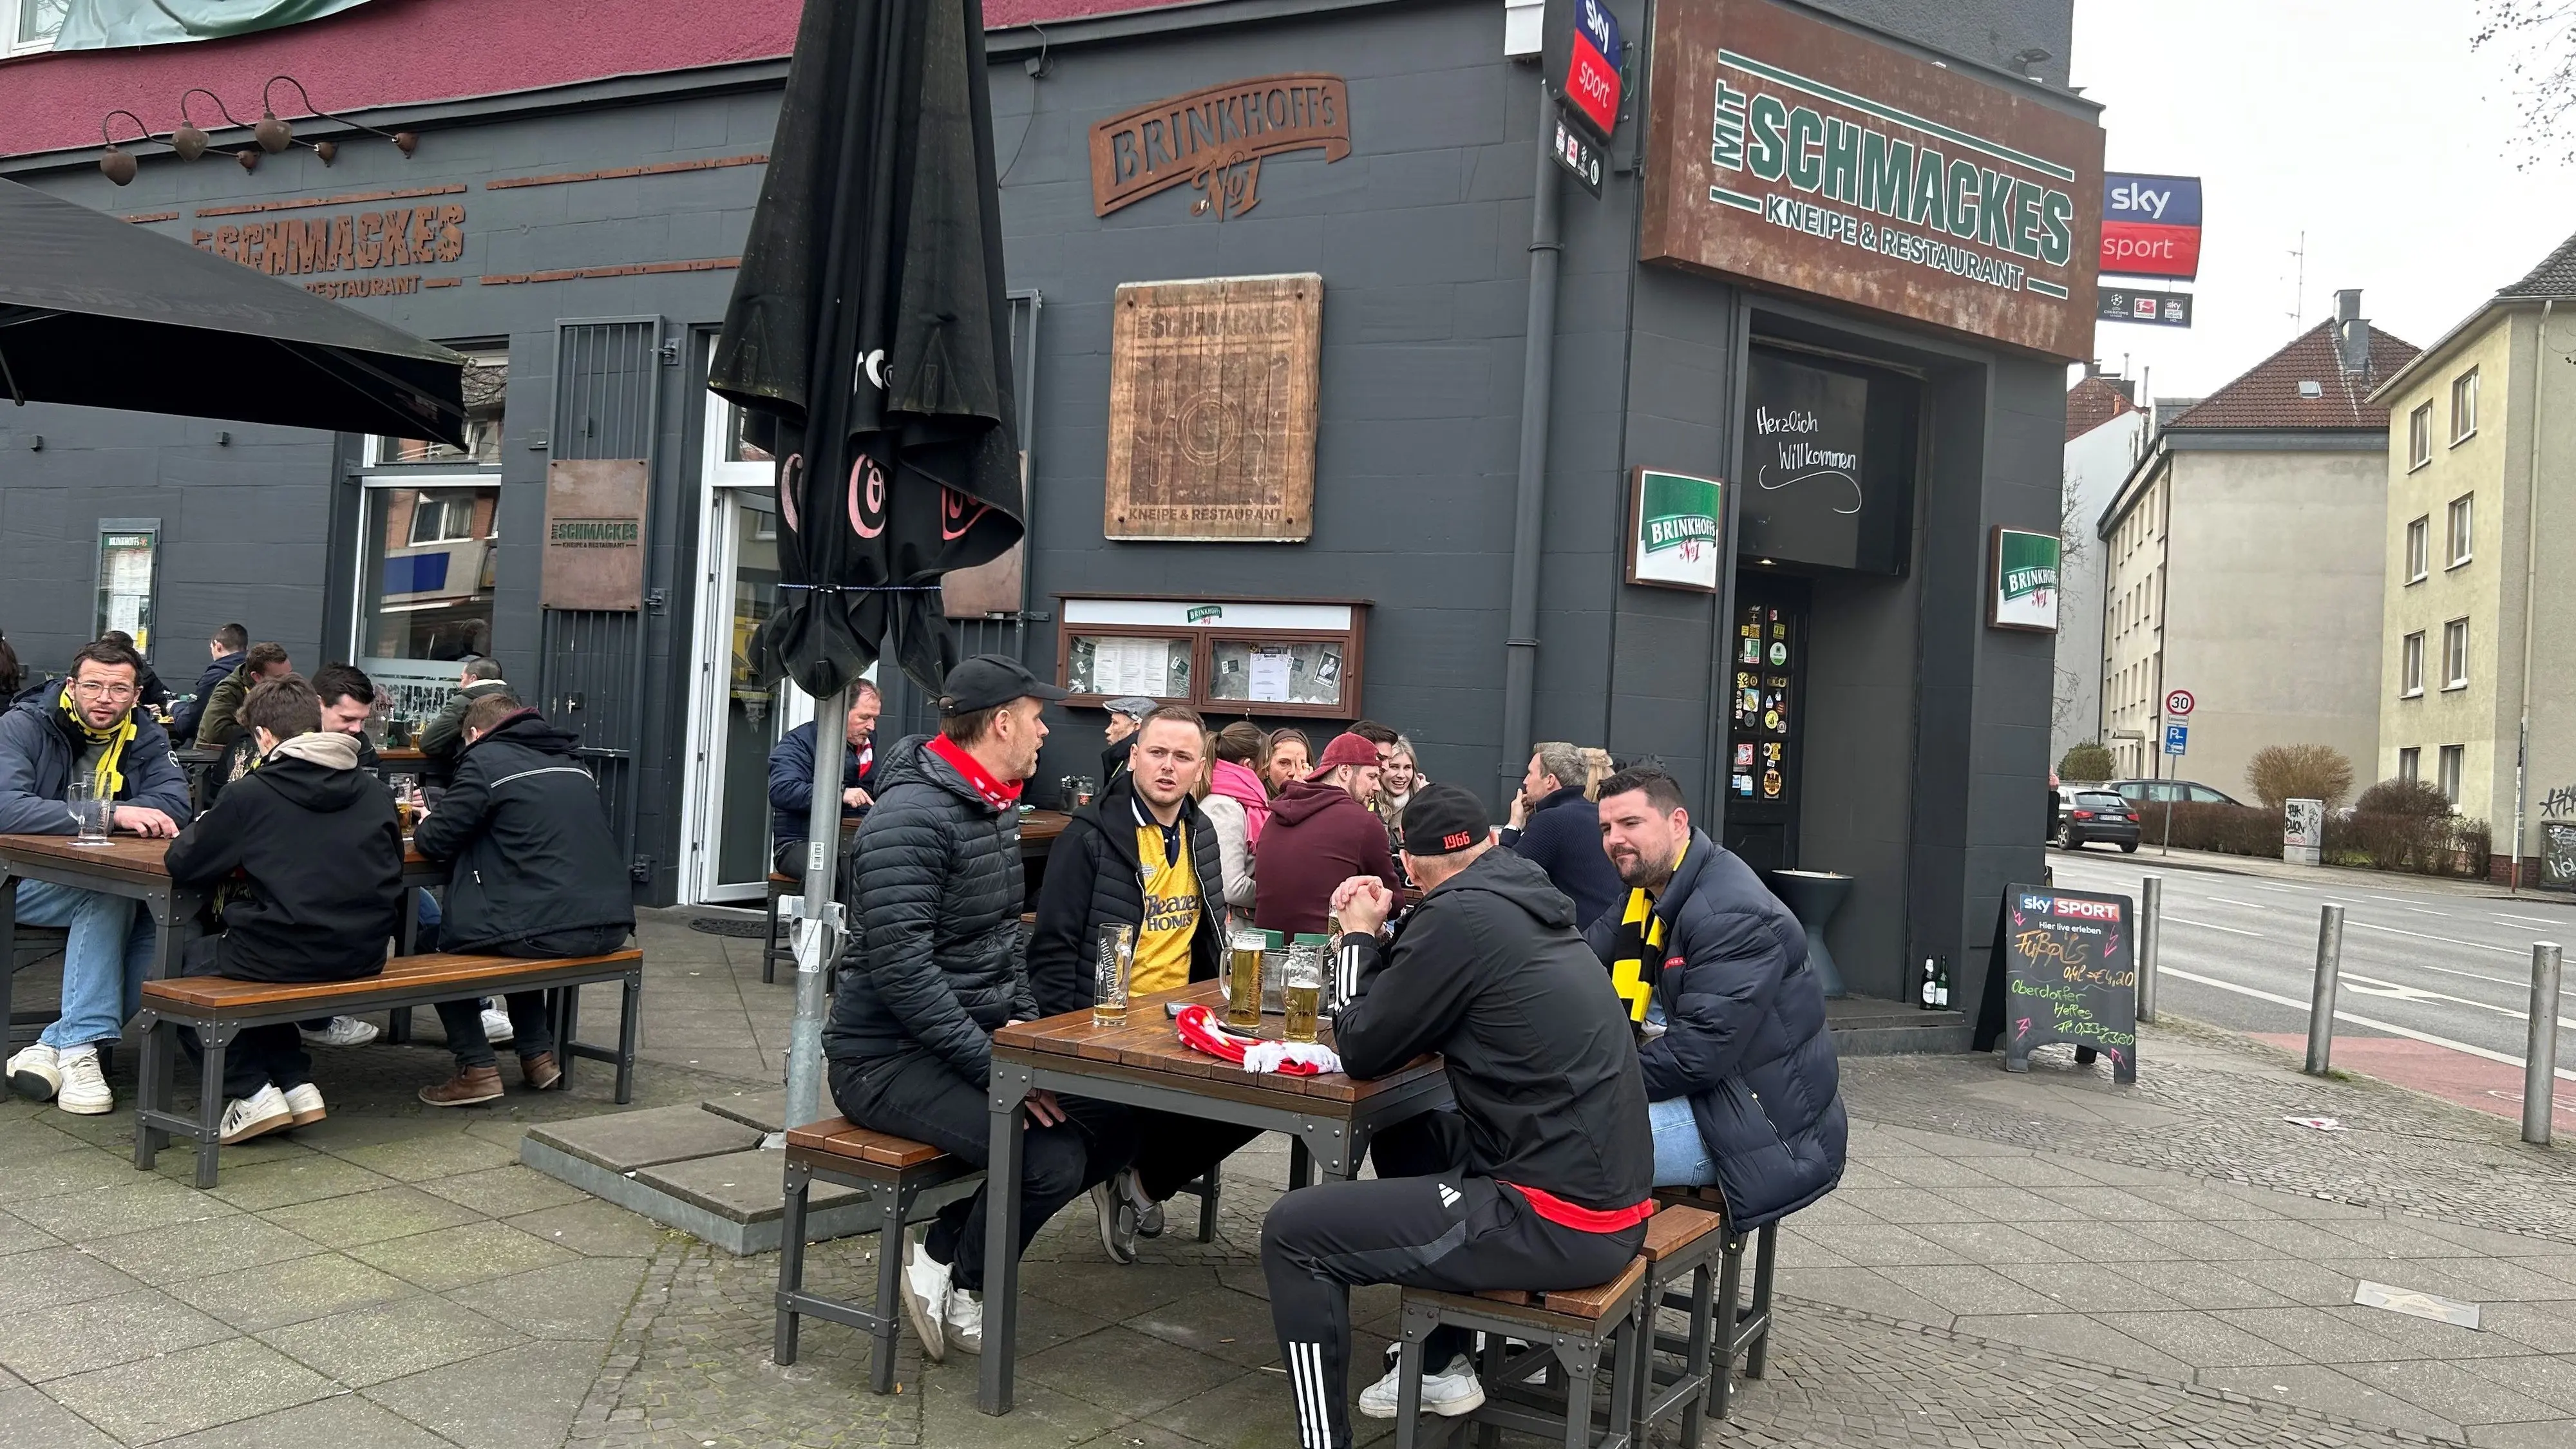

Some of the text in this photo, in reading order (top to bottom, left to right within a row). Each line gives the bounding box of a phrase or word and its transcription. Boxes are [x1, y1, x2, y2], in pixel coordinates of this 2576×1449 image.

[1585, 0, 1609, 54] sky
[1578, 61, 1610, 109] sport
[1712, 79, 2072, 267] MIT SCHMACKES
[2110, 182, 2171, 220] sky
[1765, 194, 2024, 292] KNEIPE & RESTAURANT
[2102, 237, 2174, 260] sport
[1756, 406, 1819, 435] Herzlich
[1778, 441, 1856, 471] Willkommen
[1128, 508, 1282, 521] KNEIPE & RESTAURANT
[558, 524, 639, 540] SCHMACKES
[2172, 697, 2189, 709] 30
[2169, 728, 2179, 739] P
[1443, 831, 1470, 850] 1966
[1145, 894, 1201, 916] Beazer
[2023, 896, 2116, 918] sky SPORT
[1146, 912, 1193, 931] HOMES
[2039, 921, 2101, 934] Hier live erleben
[2011, 980, 2087, 1002] Oberdorfer
